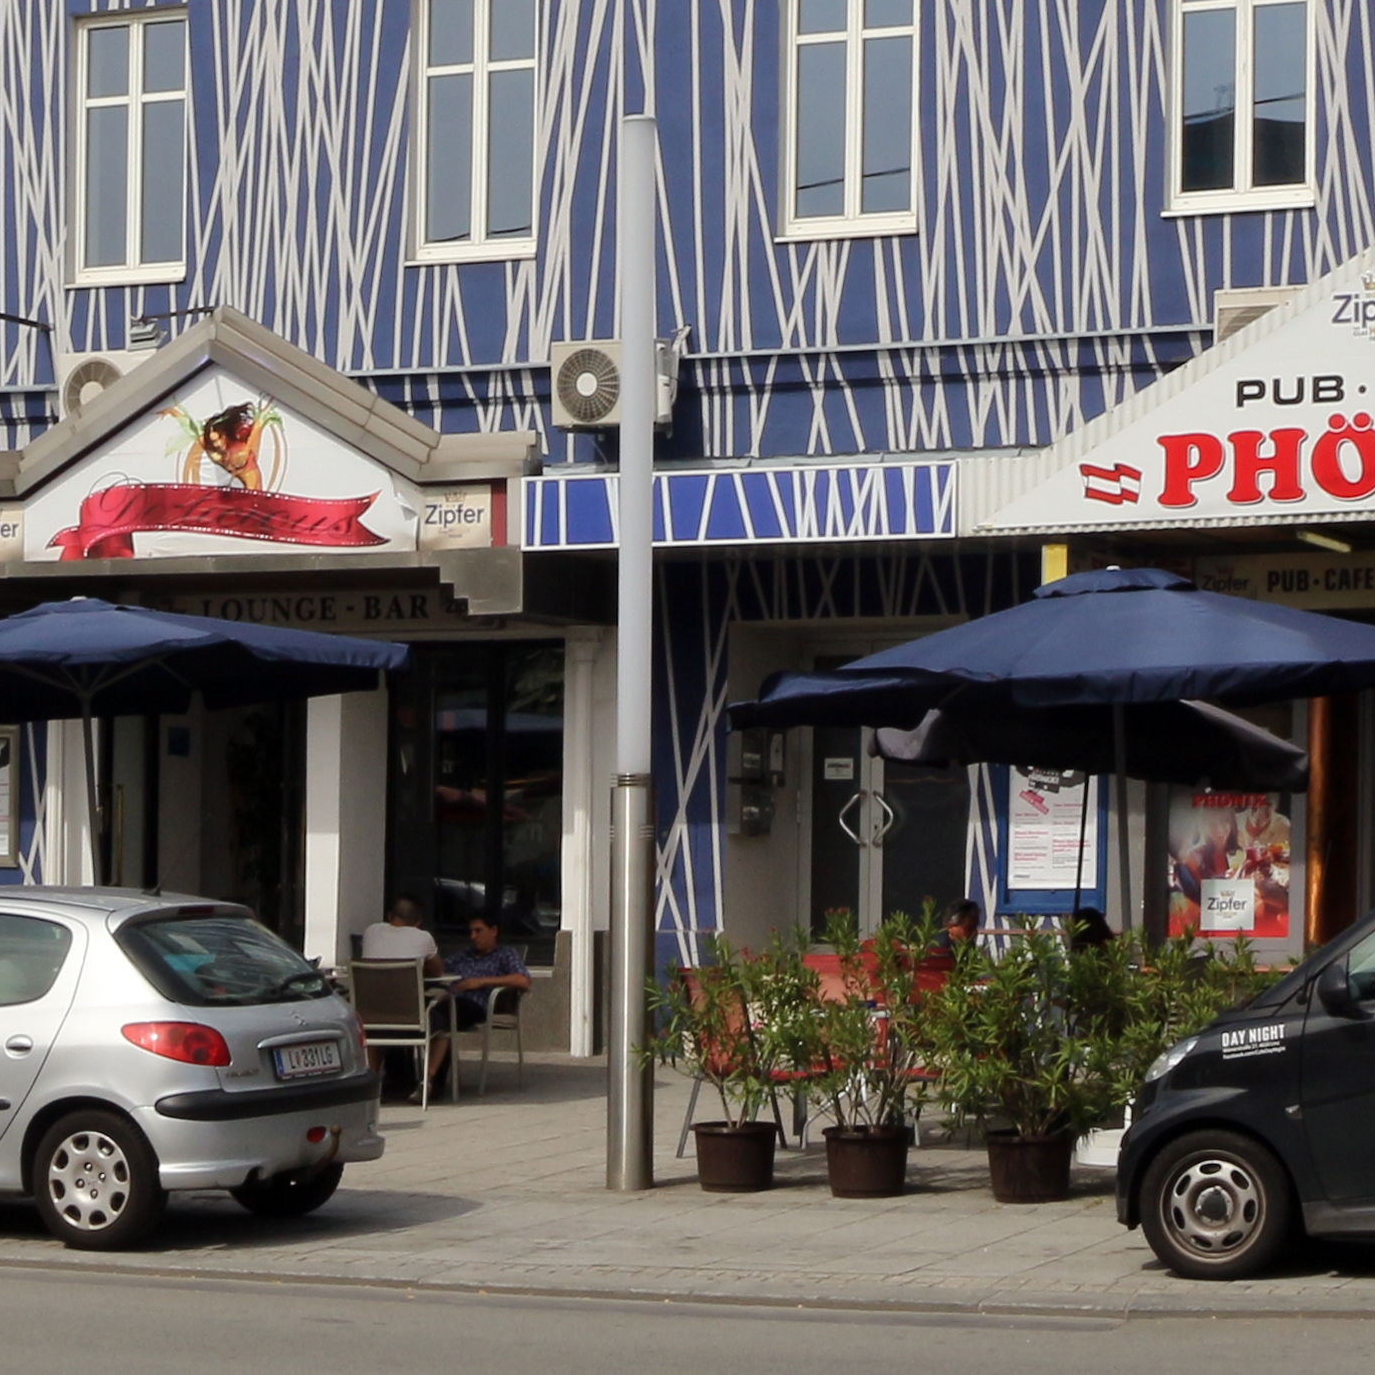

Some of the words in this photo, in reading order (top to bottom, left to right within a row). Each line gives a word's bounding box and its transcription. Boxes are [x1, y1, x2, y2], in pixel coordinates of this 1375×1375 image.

[1236, 374, 1344, 408] PUB
[424, 504, 484, 528] Zipfer
[1201, 574, 1250, 596] Zipfer
[1267, 570, 1310, 593] PUB
[1324, 567, 1374, 592] CAFE
[203, 596, 337, 622] LOUNGE
[364, 594, 429, 620] BAR
[1207, 897, 1247, 911] Zipfer
[1222, 1030, 1245, 1047] DAY
[1249, 1024, 1285, 1043] NIGHT
